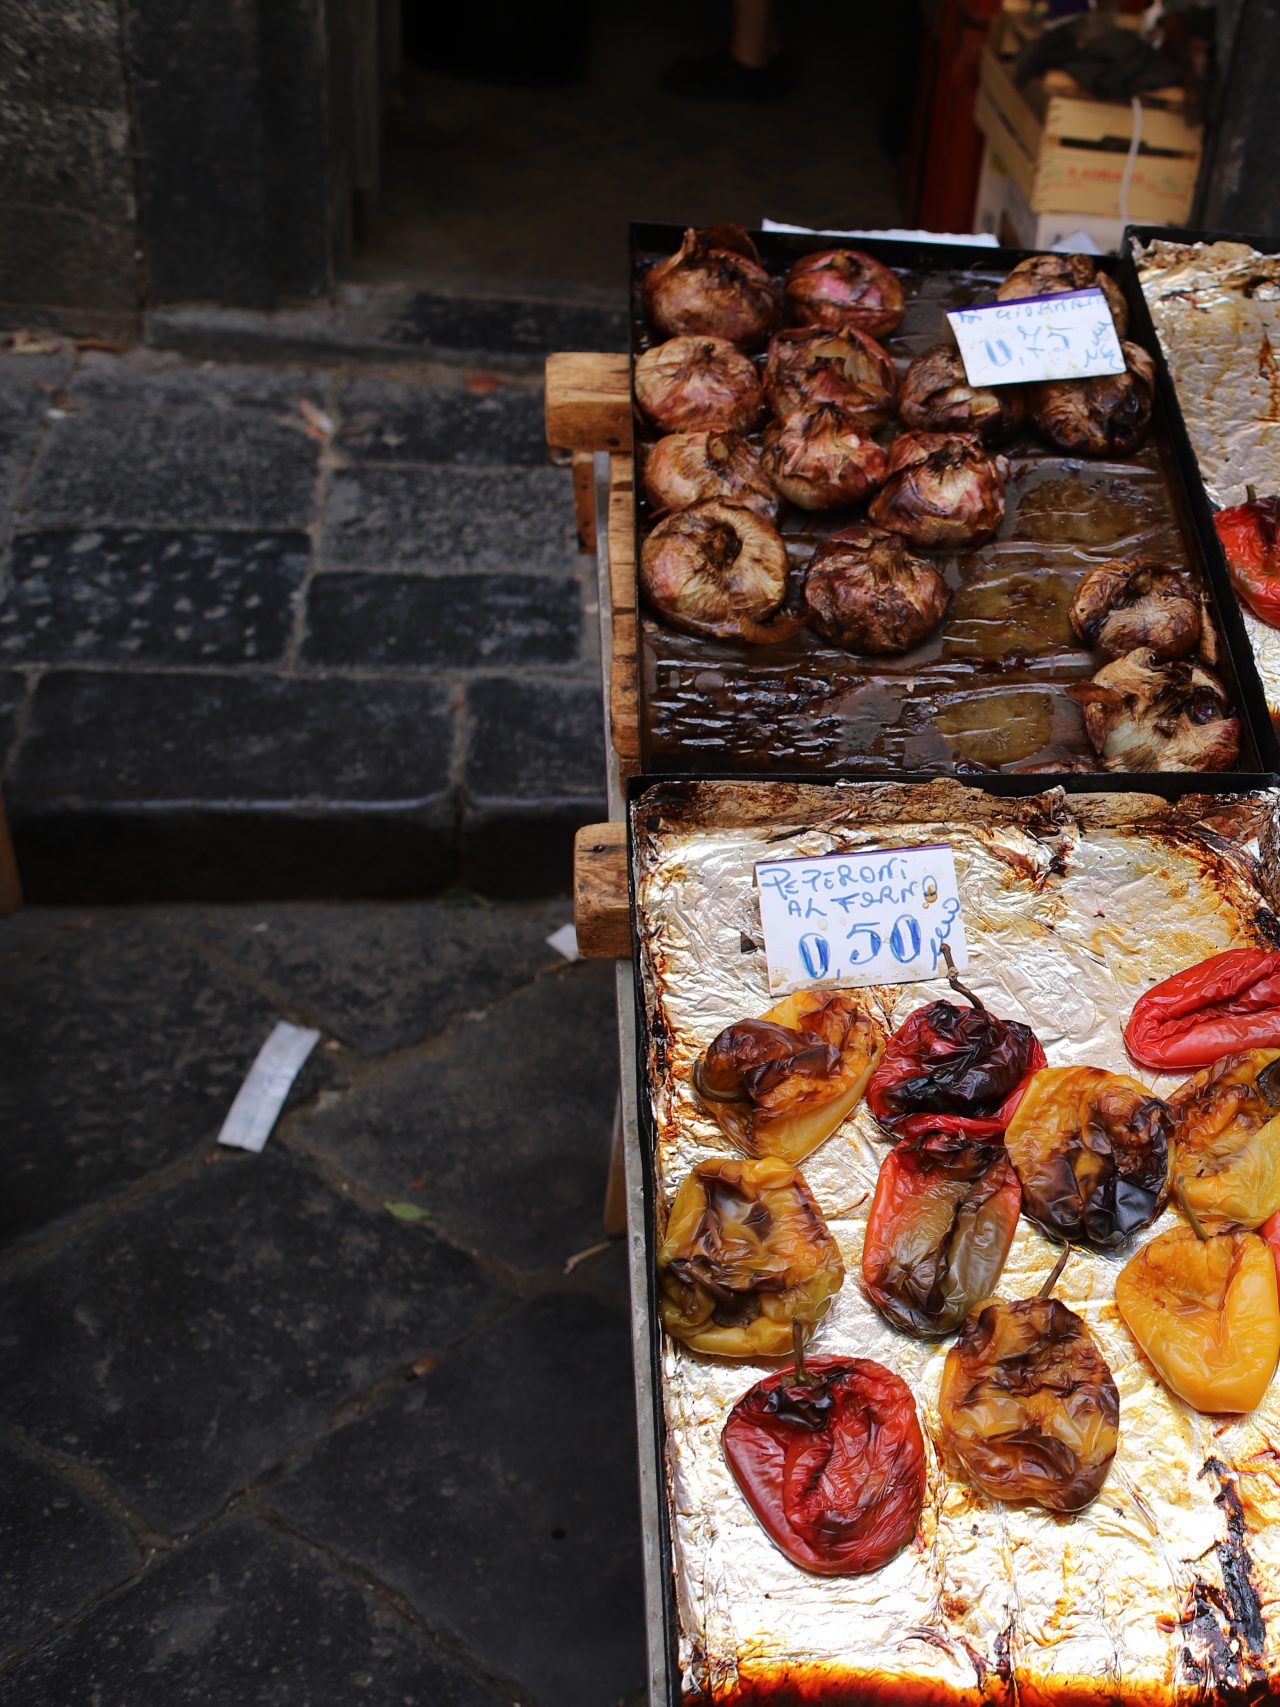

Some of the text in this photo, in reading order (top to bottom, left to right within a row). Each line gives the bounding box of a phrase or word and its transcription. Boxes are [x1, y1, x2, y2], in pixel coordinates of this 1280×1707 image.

[788, 875, 939, 919] AL FORNO
[798, 914, 922, 981] 0,50
